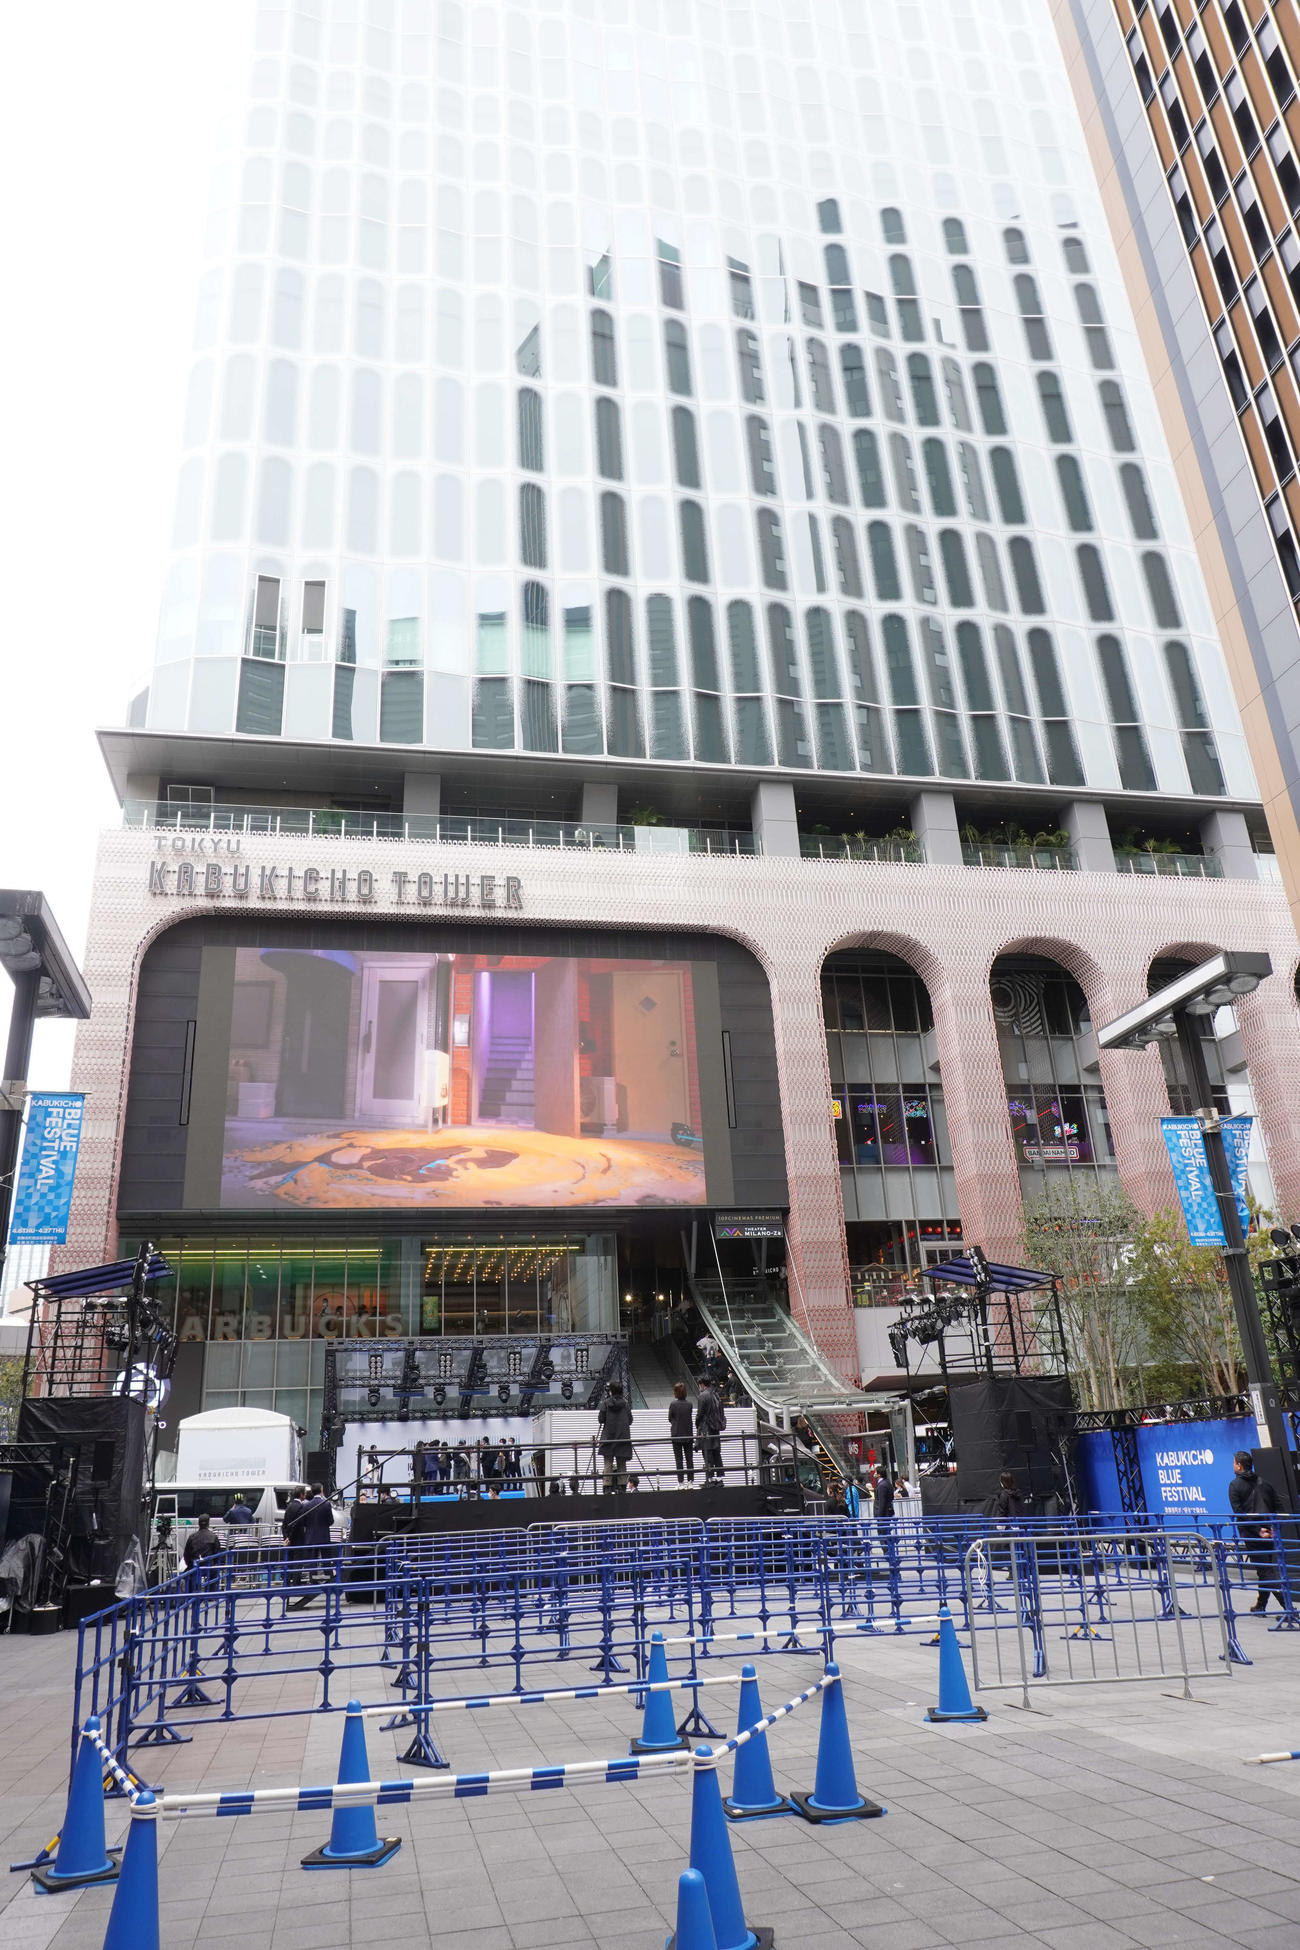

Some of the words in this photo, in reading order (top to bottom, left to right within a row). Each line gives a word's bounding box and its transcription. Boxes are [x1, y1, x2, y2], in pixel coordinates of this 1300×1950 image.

[153, 835, 241, 854] TOKYU
[149, 860, 374, 899] KABUKICHO
[392, 870, 523, 905] TOWER
[31, 1099, 82, 1108] KABUKICHO
[60, 1108, 82, 1152] BLUE
[36, 1107, 64, 1190] FESTIVAL
[1189, 1130, 1207, 1168] BLUE
[1177, 1130, 1204, 1200] FESTIVAL
[1155, 1448, 1214, 1467] KABUKICHO
[1158, 1469, 1183, 1484] BLUE
[1161, 1486, 1207, 1502] FESTIVAL
